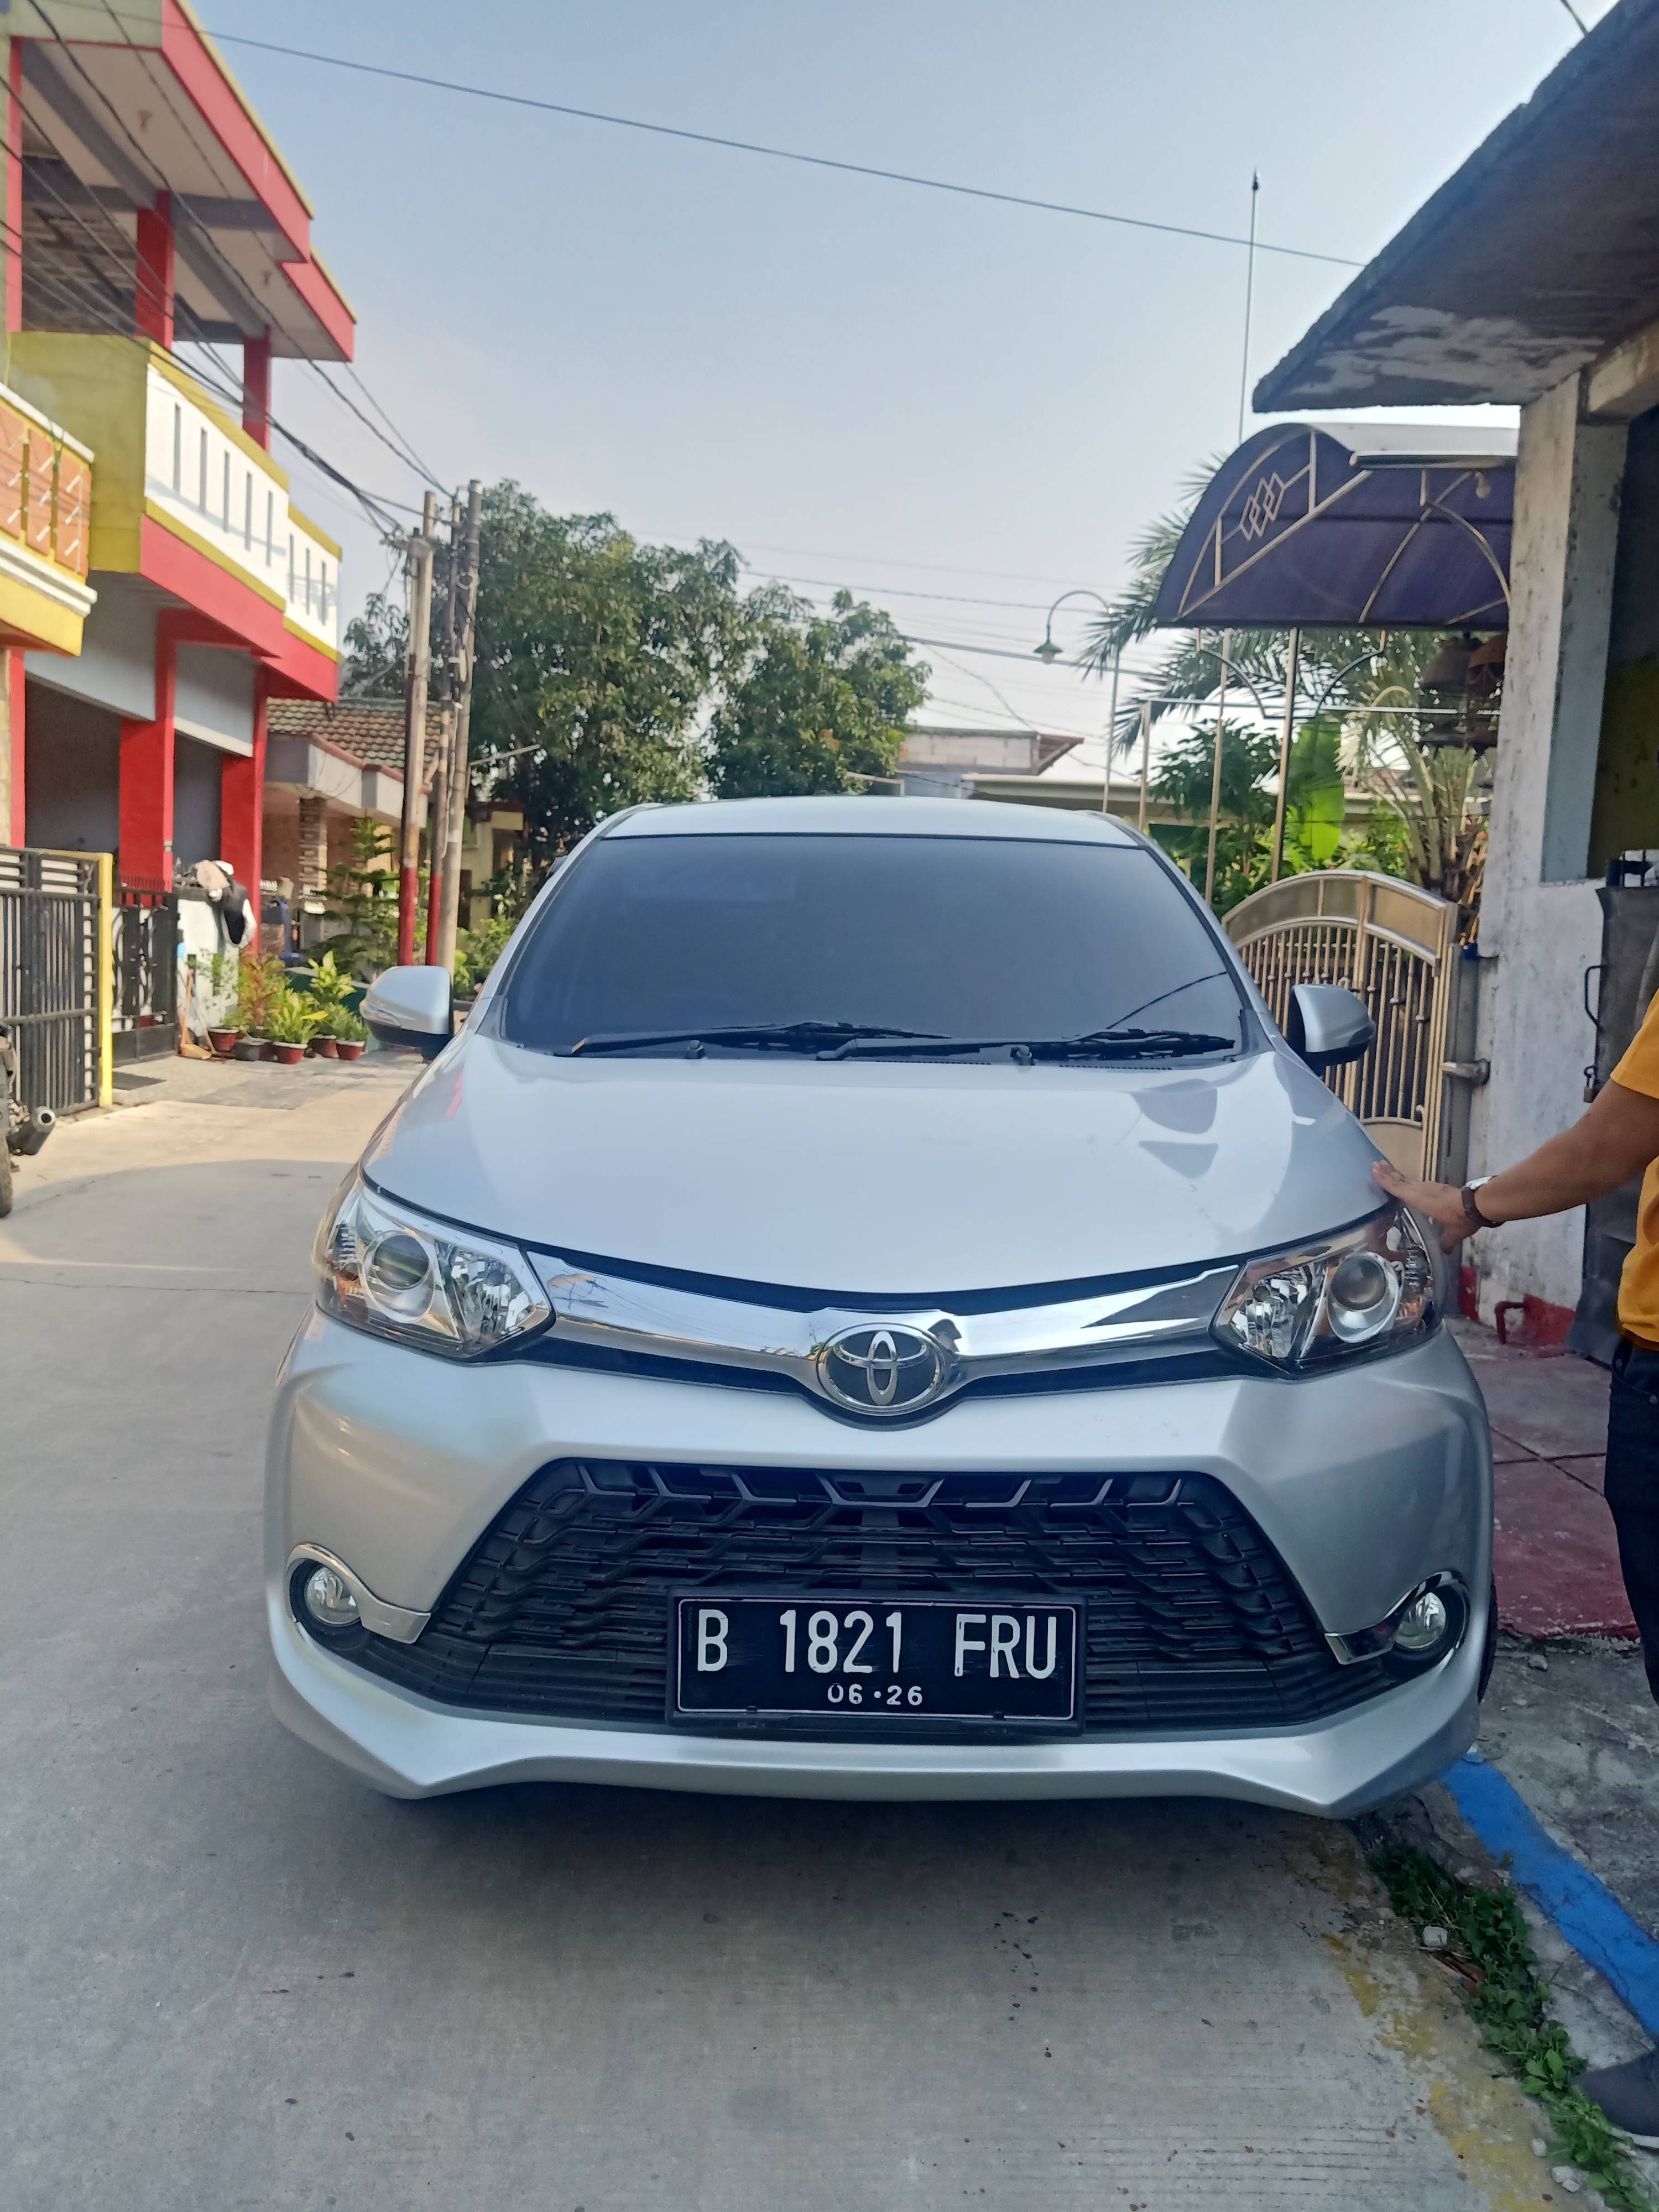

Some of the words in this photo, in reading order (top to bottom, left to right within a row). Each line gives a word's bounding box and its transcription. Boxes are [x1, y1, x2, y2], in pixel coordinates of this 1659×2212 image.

[697, 1609, 728, 1672] B
[780, 1610, 901, 1673] 1821
[954, 1614, 1057, 1679] FRU
